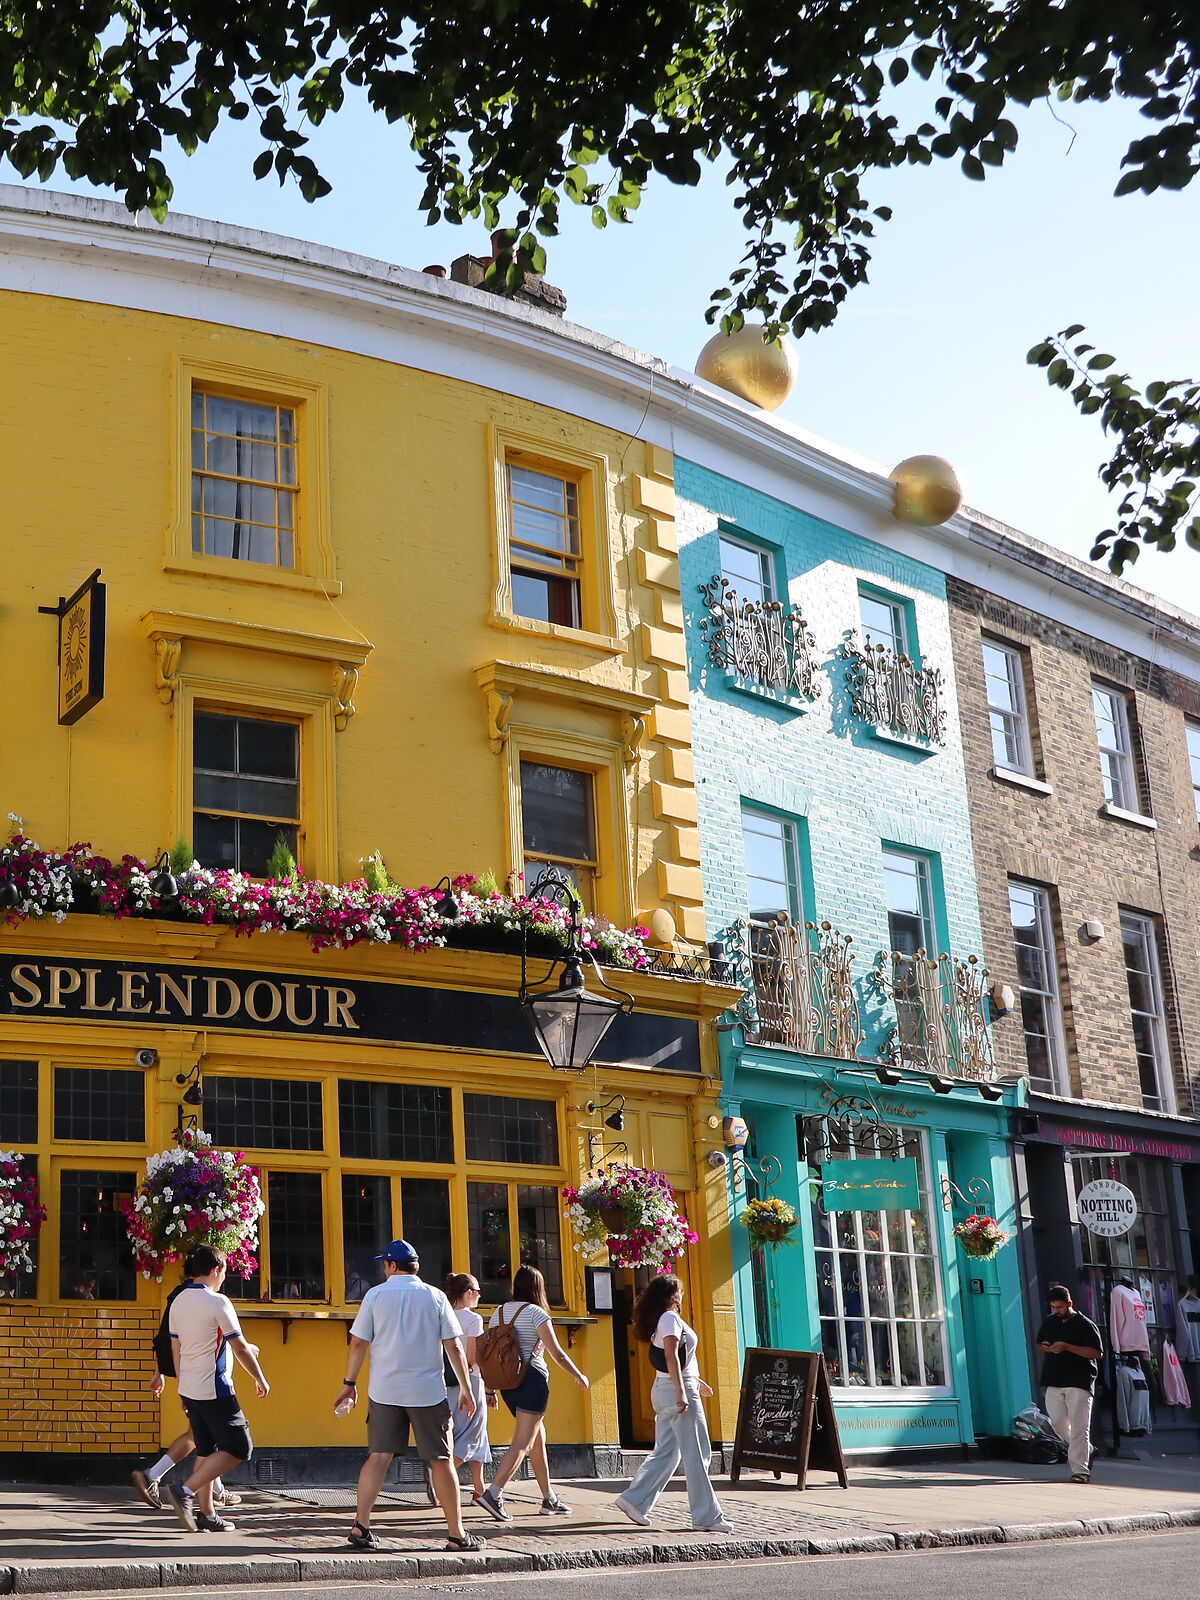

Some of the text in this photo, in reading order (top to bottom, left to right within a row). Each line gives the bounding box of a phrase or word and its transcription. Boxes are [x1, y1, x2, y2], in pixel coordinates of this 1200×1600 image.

[8, 963, 360, 1029] SPLENDOUR
[1056, 1126, 1109, 1148] NOTTING
[1110, 1134, 1139, 1152] HILL
[1141, 1139, 1195, 1160] COMPANY
[1088, 1181, 1122, 1193] LONDON
[1080, 1199, 1133, 1214] NOTTING
[1096, 1212, 1120, 1222] HILL
[1088, 1222, 1129, 1235] COMPANY
[757, 1405, 794, 1427] Garden
